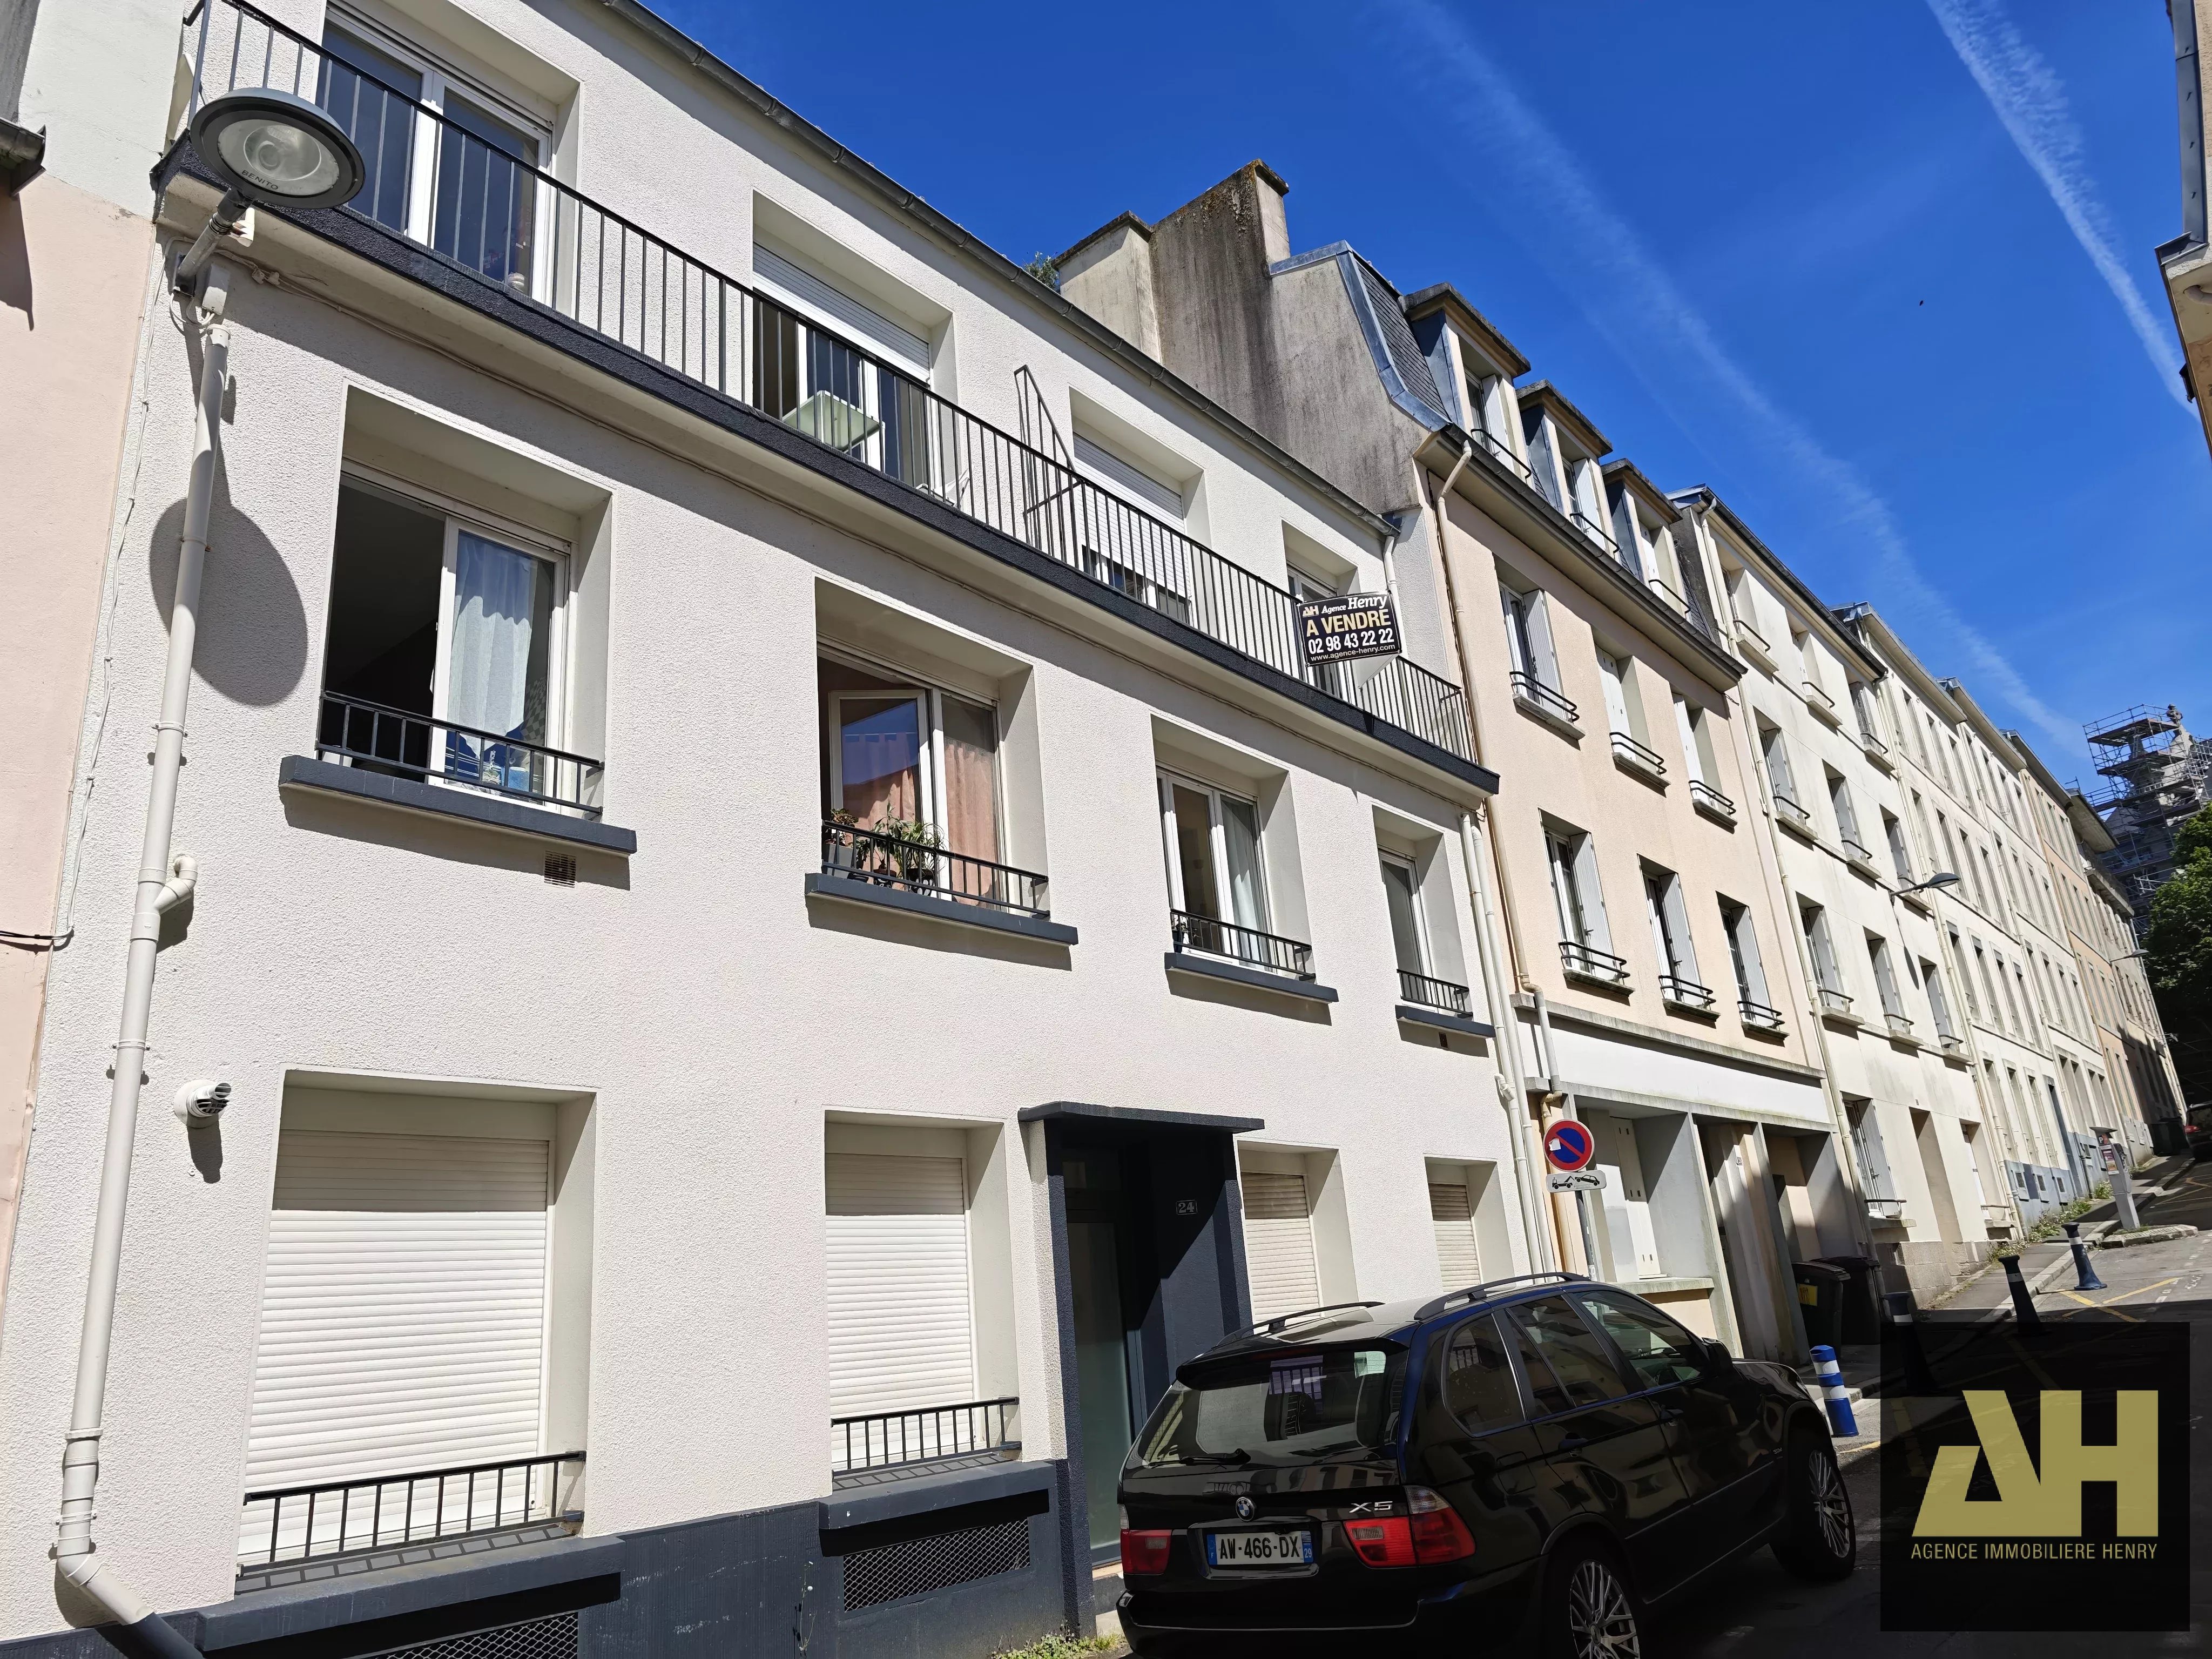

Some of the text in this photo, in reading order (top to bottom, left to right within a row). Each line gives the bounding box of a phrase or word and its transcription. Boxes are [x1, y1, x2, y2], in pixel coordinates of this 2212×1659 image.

[241, 170, 279, 190] BENITO
[1321, 596, 1387, 615] Agence Henry
[1306, 609, 1391, 637] A VENDRE
[1308, 628, 1394, 655] 02 98 43 22 22
[1311, 644, 1395, 662] www.agence-henry.com
[1178, 1202, 1195, 1213] 24
[1349, 1501, 1393, 1513] X5
[1220, 1536, 1300, 1559] AW-466-DX
[1304, 1548, 1312, 1558] 29
